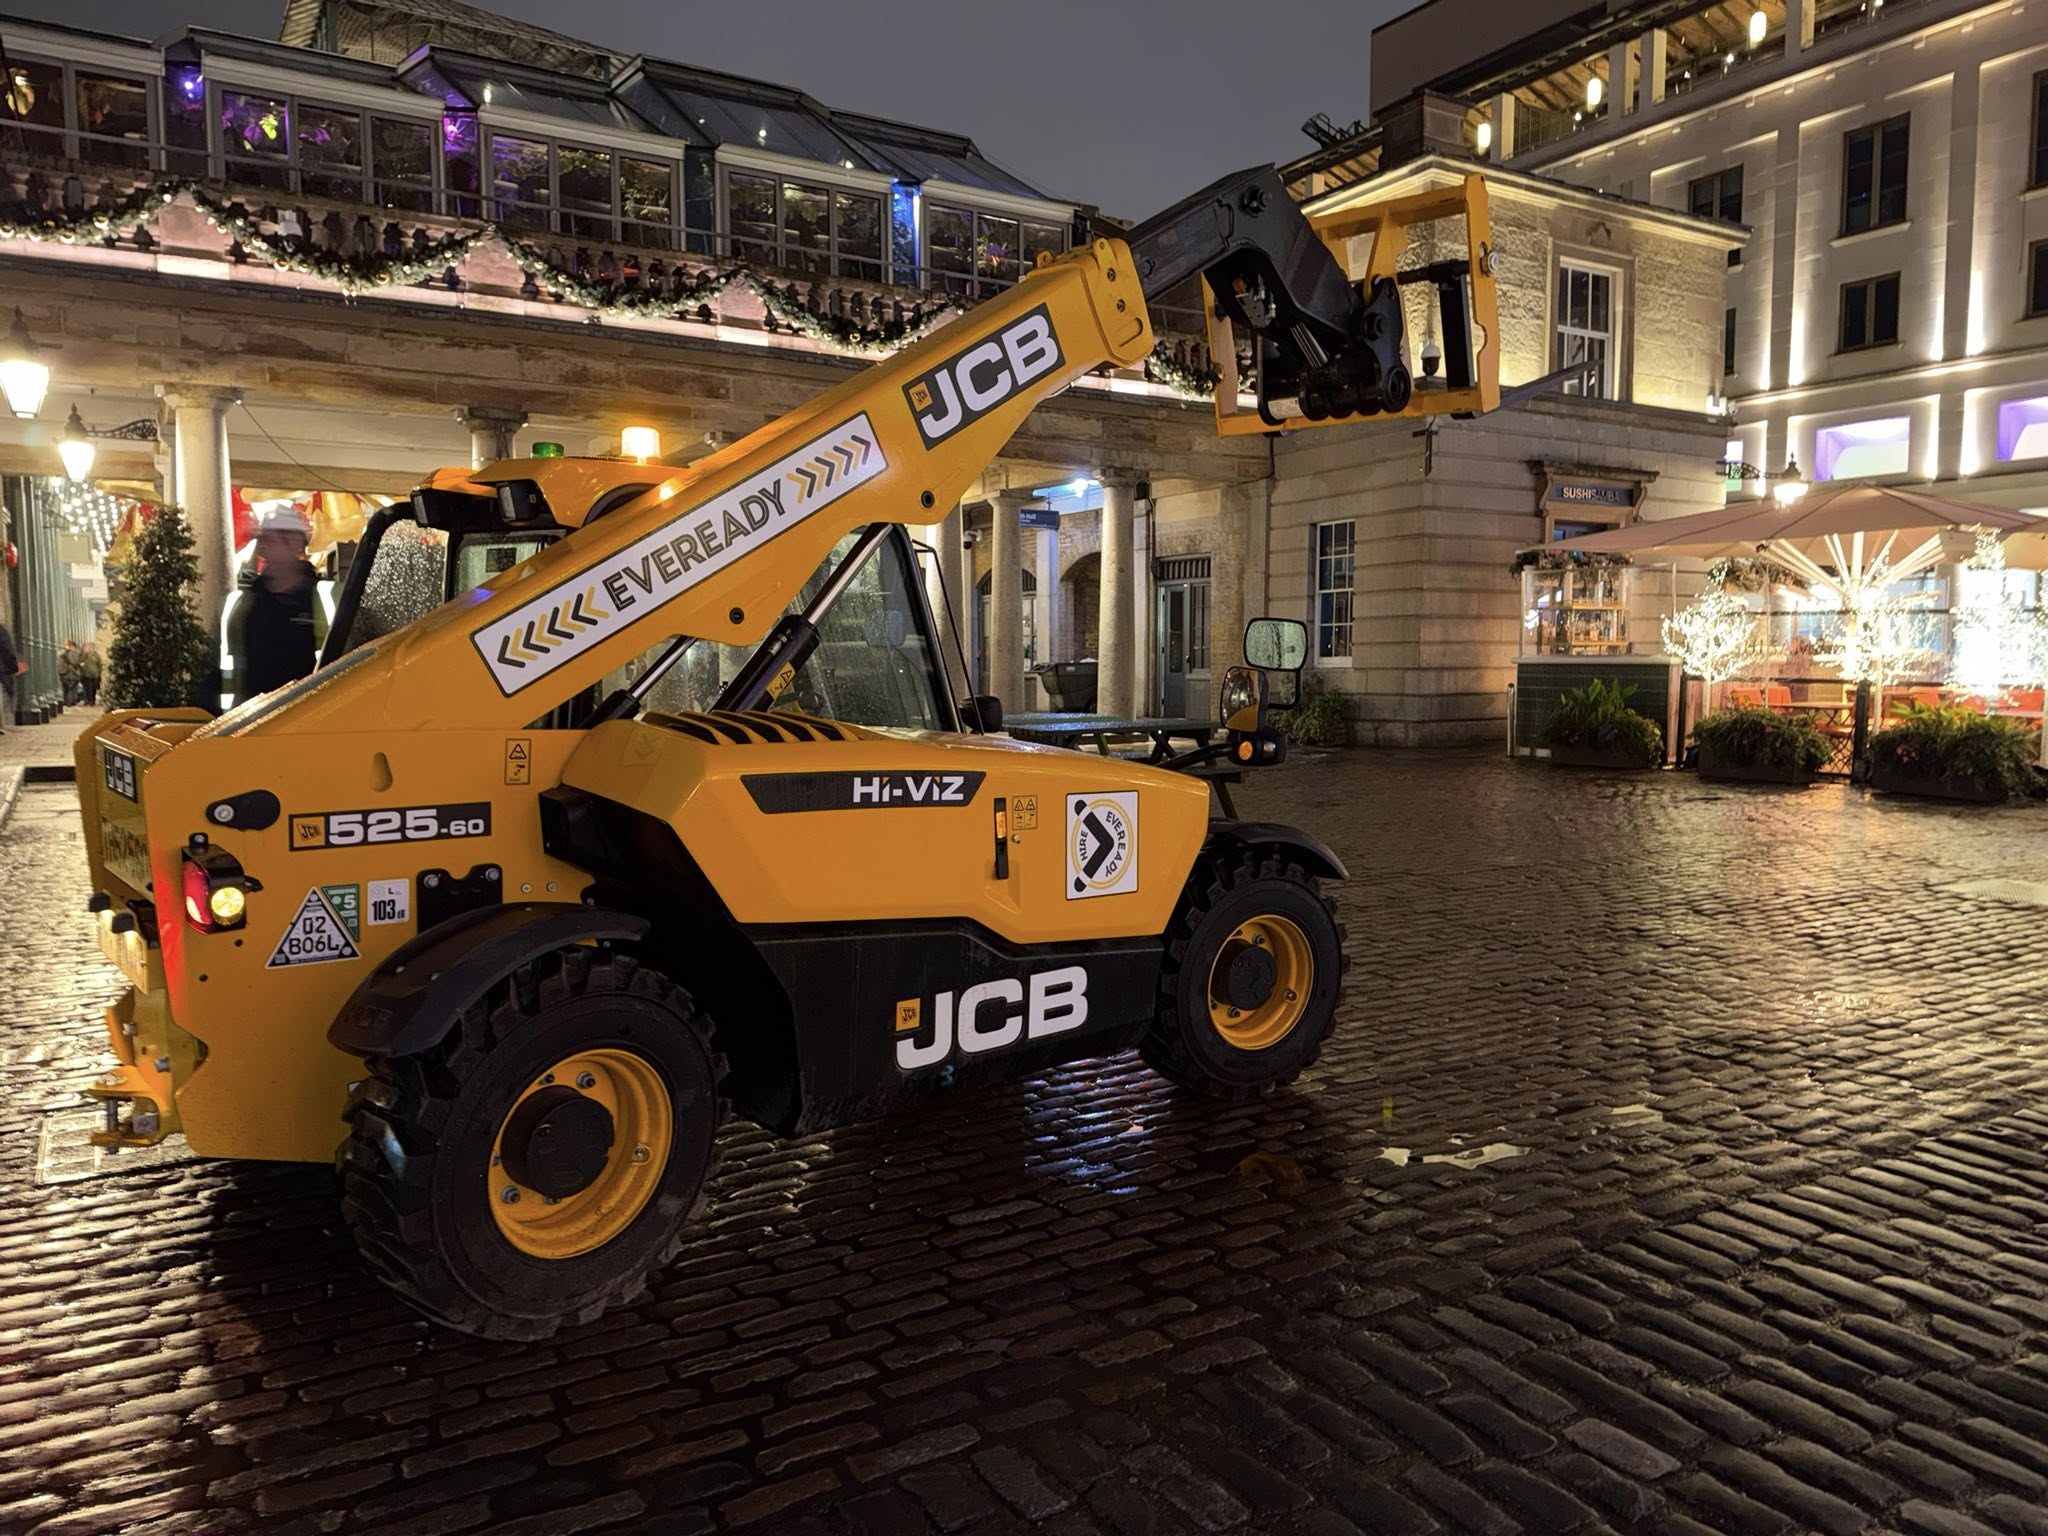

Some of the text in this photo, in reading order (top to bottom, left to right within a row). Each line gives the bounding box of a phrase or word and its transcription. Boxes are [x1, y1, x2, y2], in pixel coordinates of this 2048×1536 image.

[920, 314, 1060, 439] JCB
[603, 479, 786, 611] EVEREADY
[1079, 830, 1089, 861] HIRE
[1106, 811, 1126, 877] EVEREADY
[303, 916, 327, 935] 02
[343, 894, 356, 909] 5
[371, 899, 396, 922] 103
[897, 966, 1089, 1069] JCB
